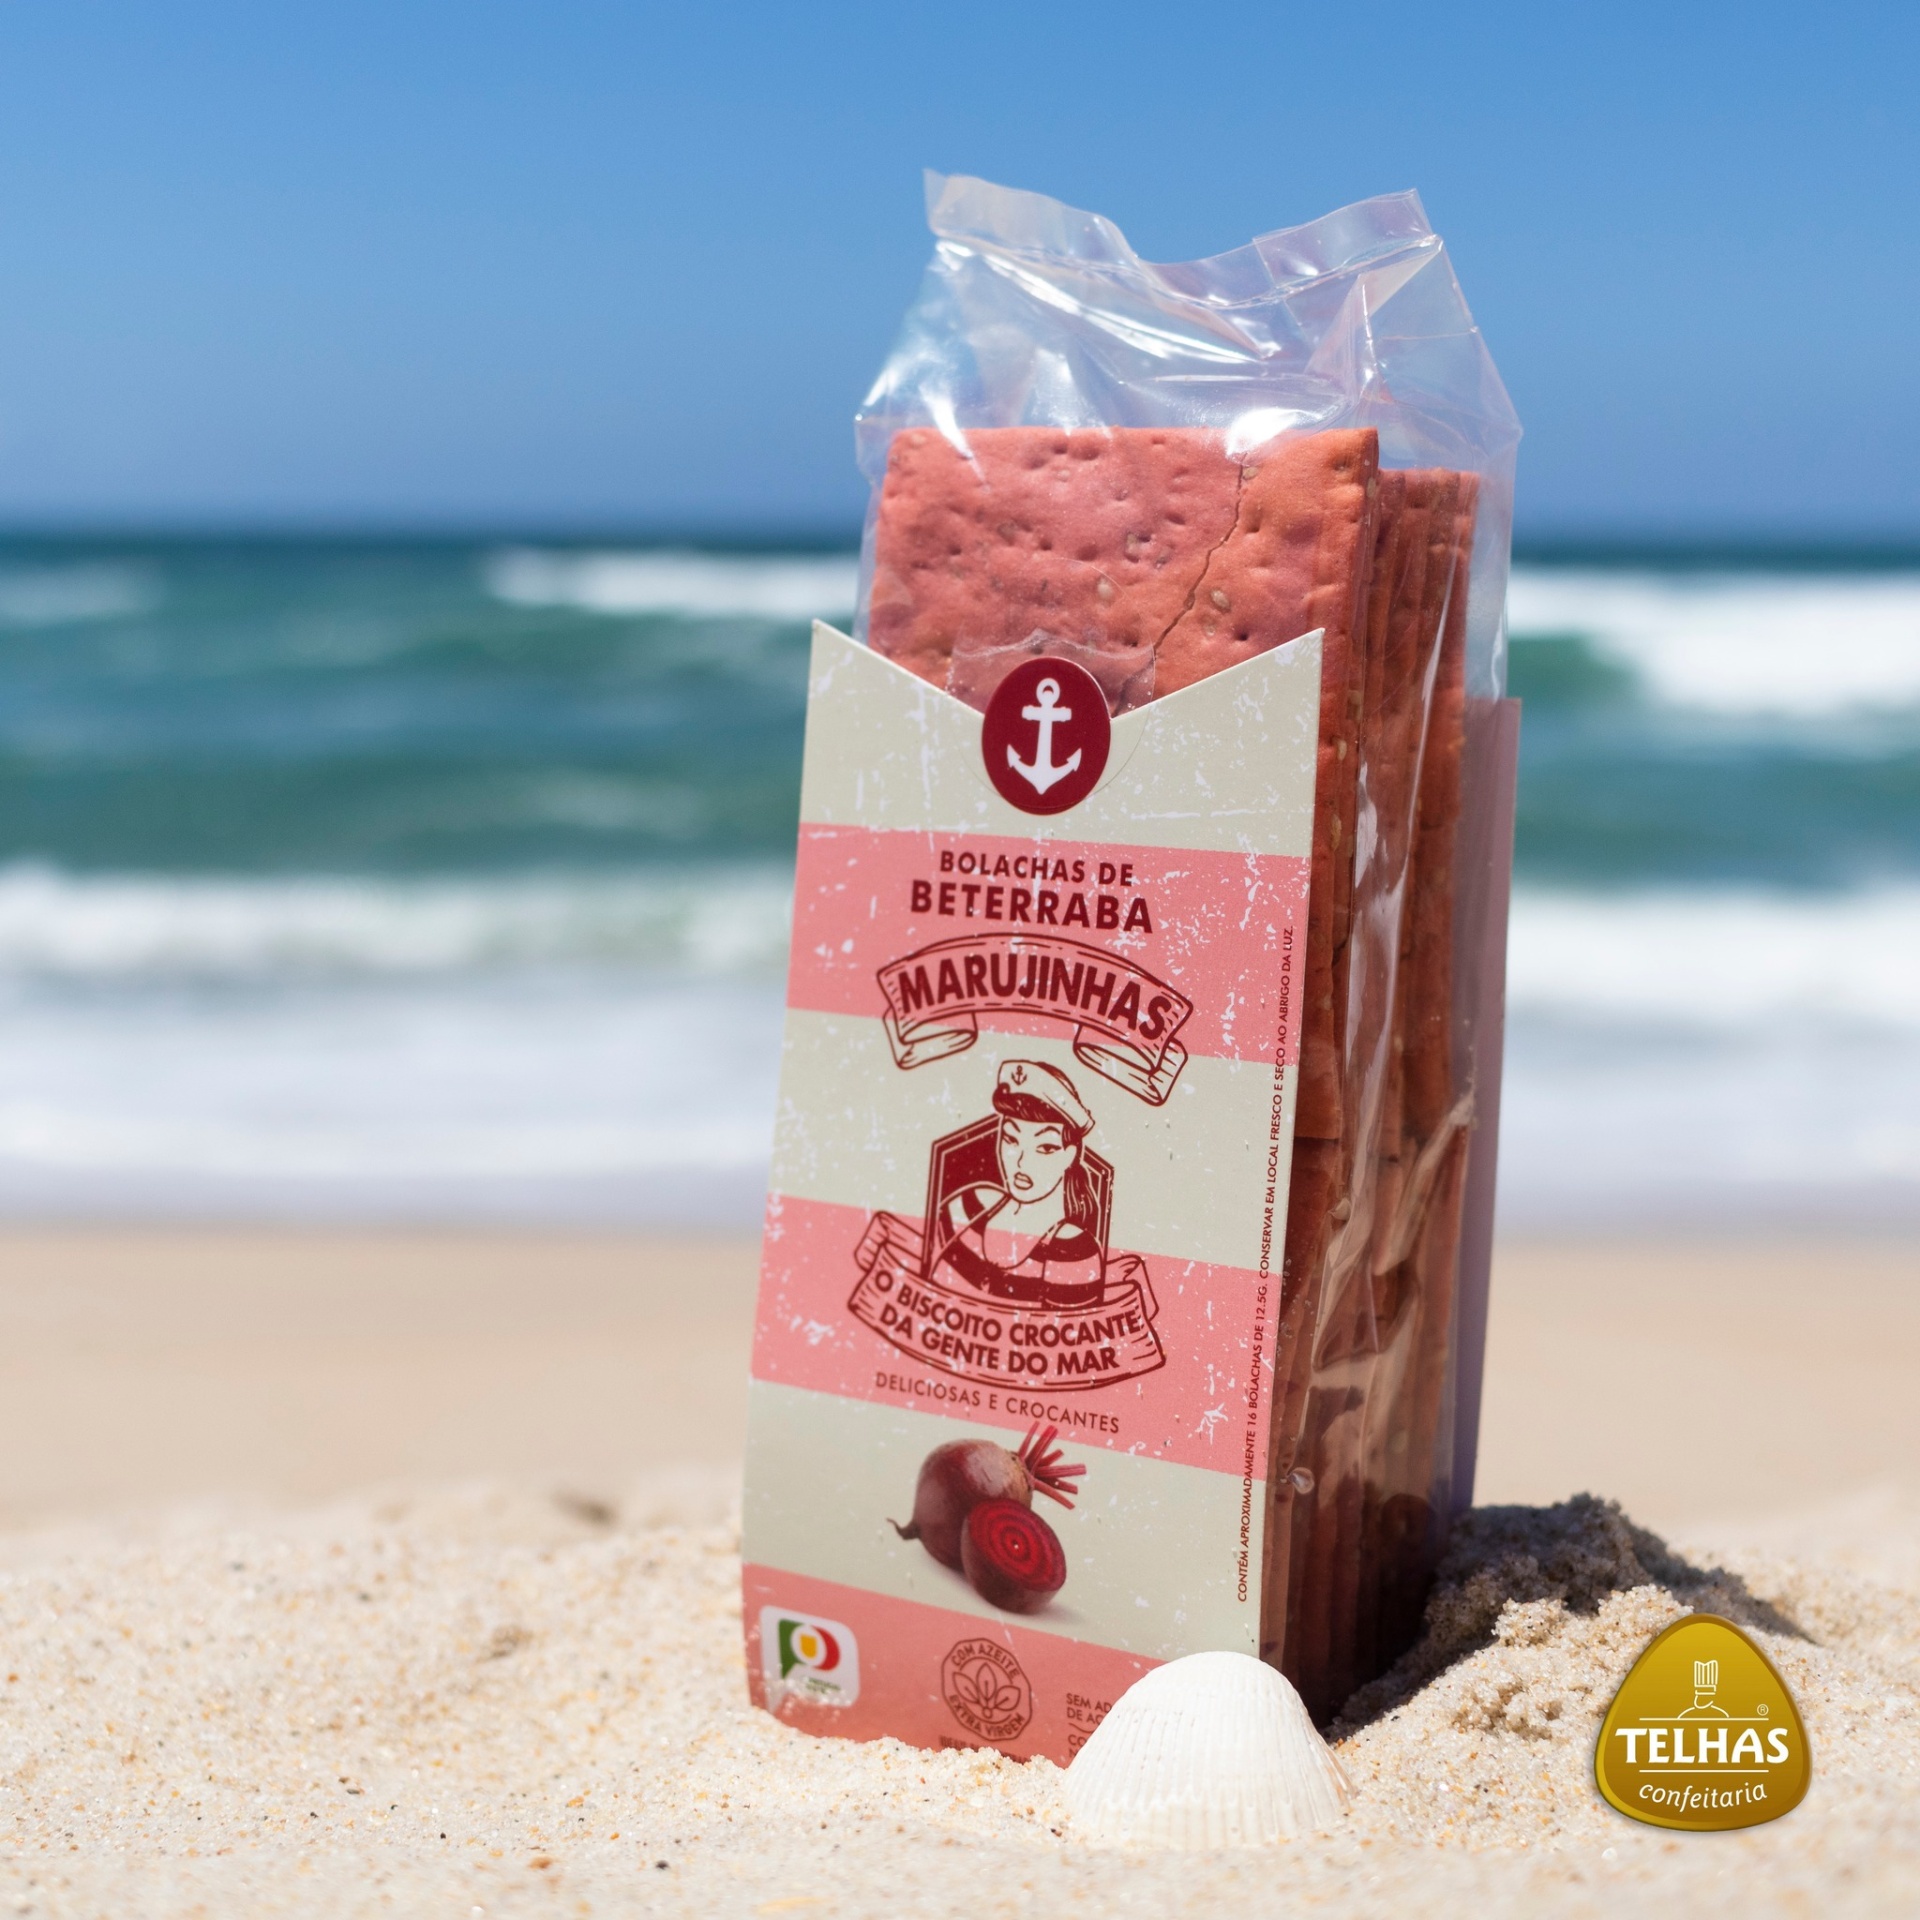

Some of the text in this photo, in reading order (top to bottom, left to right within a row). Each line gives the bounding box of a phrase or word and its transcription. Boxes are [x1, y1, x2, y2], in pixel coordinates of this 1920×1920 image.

[940, 850, 1133, 887] BOLACHAS DE
[911, 879, 1153, 933] BETERRABA
[1283, 925, 1293, 951] LUZ.
[1281, 954, 1291, 972] DA
[898, 953, 1172, 1040] MARUJINHAS
[1279, 975, 1290, 1023] ABRIGO
[1278, 1025, 1287, 1044] AO
[1275, 1048, 1285, 1080] SECO
[1273, 1083, 1283, 1091] E
[1270, 1094, 1283, 1140] FRESCO
[1267, 1144, 1279, 1183] LOCAL
[1265, 1186, 1275, 1204] EM
[1259, 1207, 1274, 1279] CONSERVAR
[875, 1270, 1141, 1348] O BISCOITO CROCANTE
[880, 1303, 1121, 1375] DA GENTE DO MAR
[1254, 1325, 1264, 1341] DE
[1248, 1344, 1262, 1408] BOLACHAS
[876, 1372, 1119, 1434] DELICIOSAS E CROCANTES
[1247, 1412, 1257, 1425] 16
[1240, 1430, 1256, 1548] APROXIMADAMENTE
[1237, 1551, 1248, 1602] CONTÉM
[951, 1644, 1020, 1680] COM AZEITE
[949, 1694, 1025, 1737] EXTRA VIRGEM
[1066, 1693, 1091, 1709] SEM
[1067, 1706, 1083, 1721] DE
